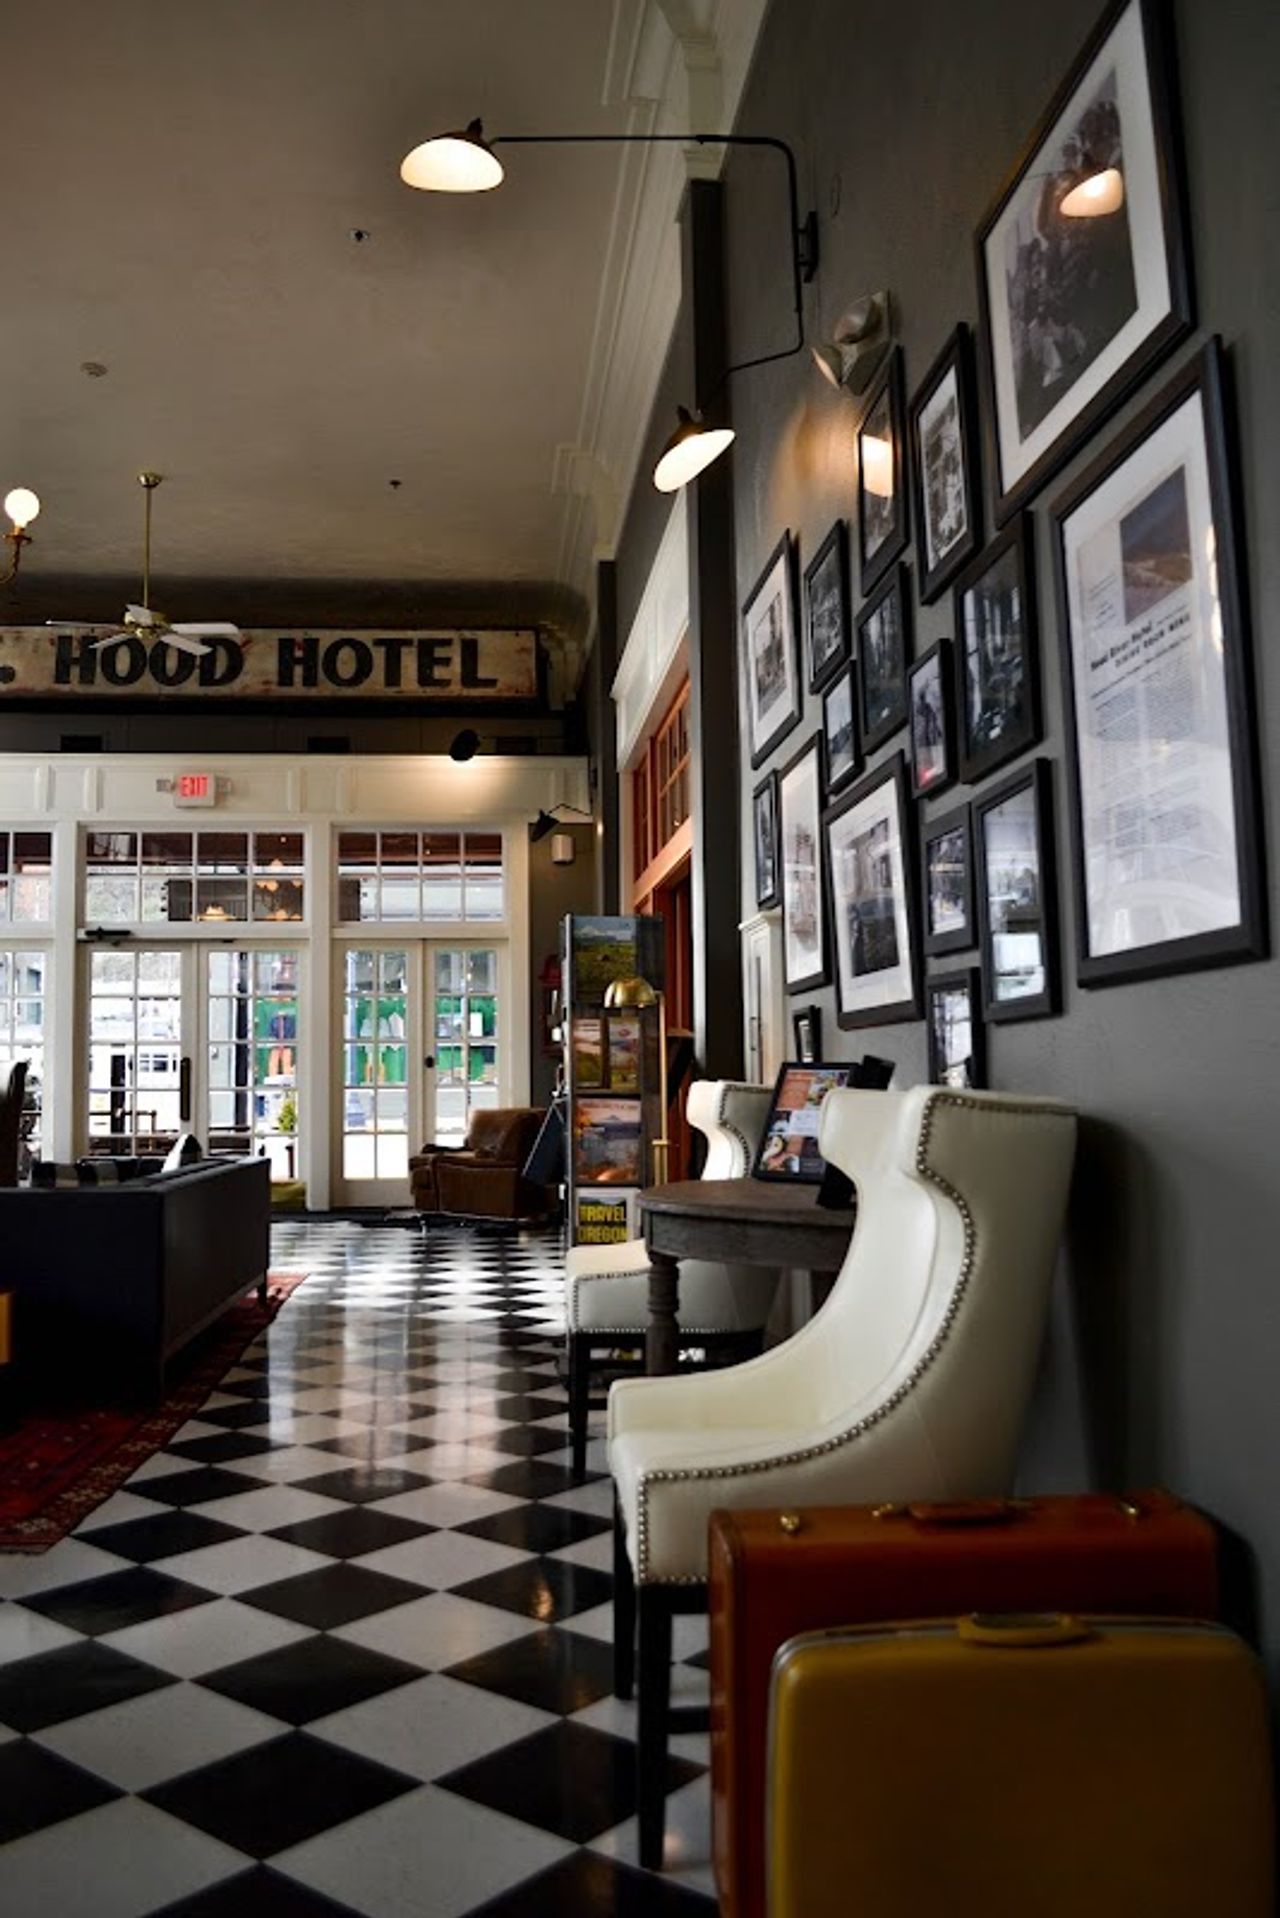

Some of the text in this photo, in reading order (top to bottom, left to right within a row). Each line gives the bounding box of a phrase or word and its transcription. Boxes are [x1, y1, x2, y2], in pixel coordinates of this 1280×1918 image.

[54, 635, 498, 688] HOOD HOTEL
[181, 776, 207, 797] EXIT
[579, 1205, 627, 1222] TRAVEL
